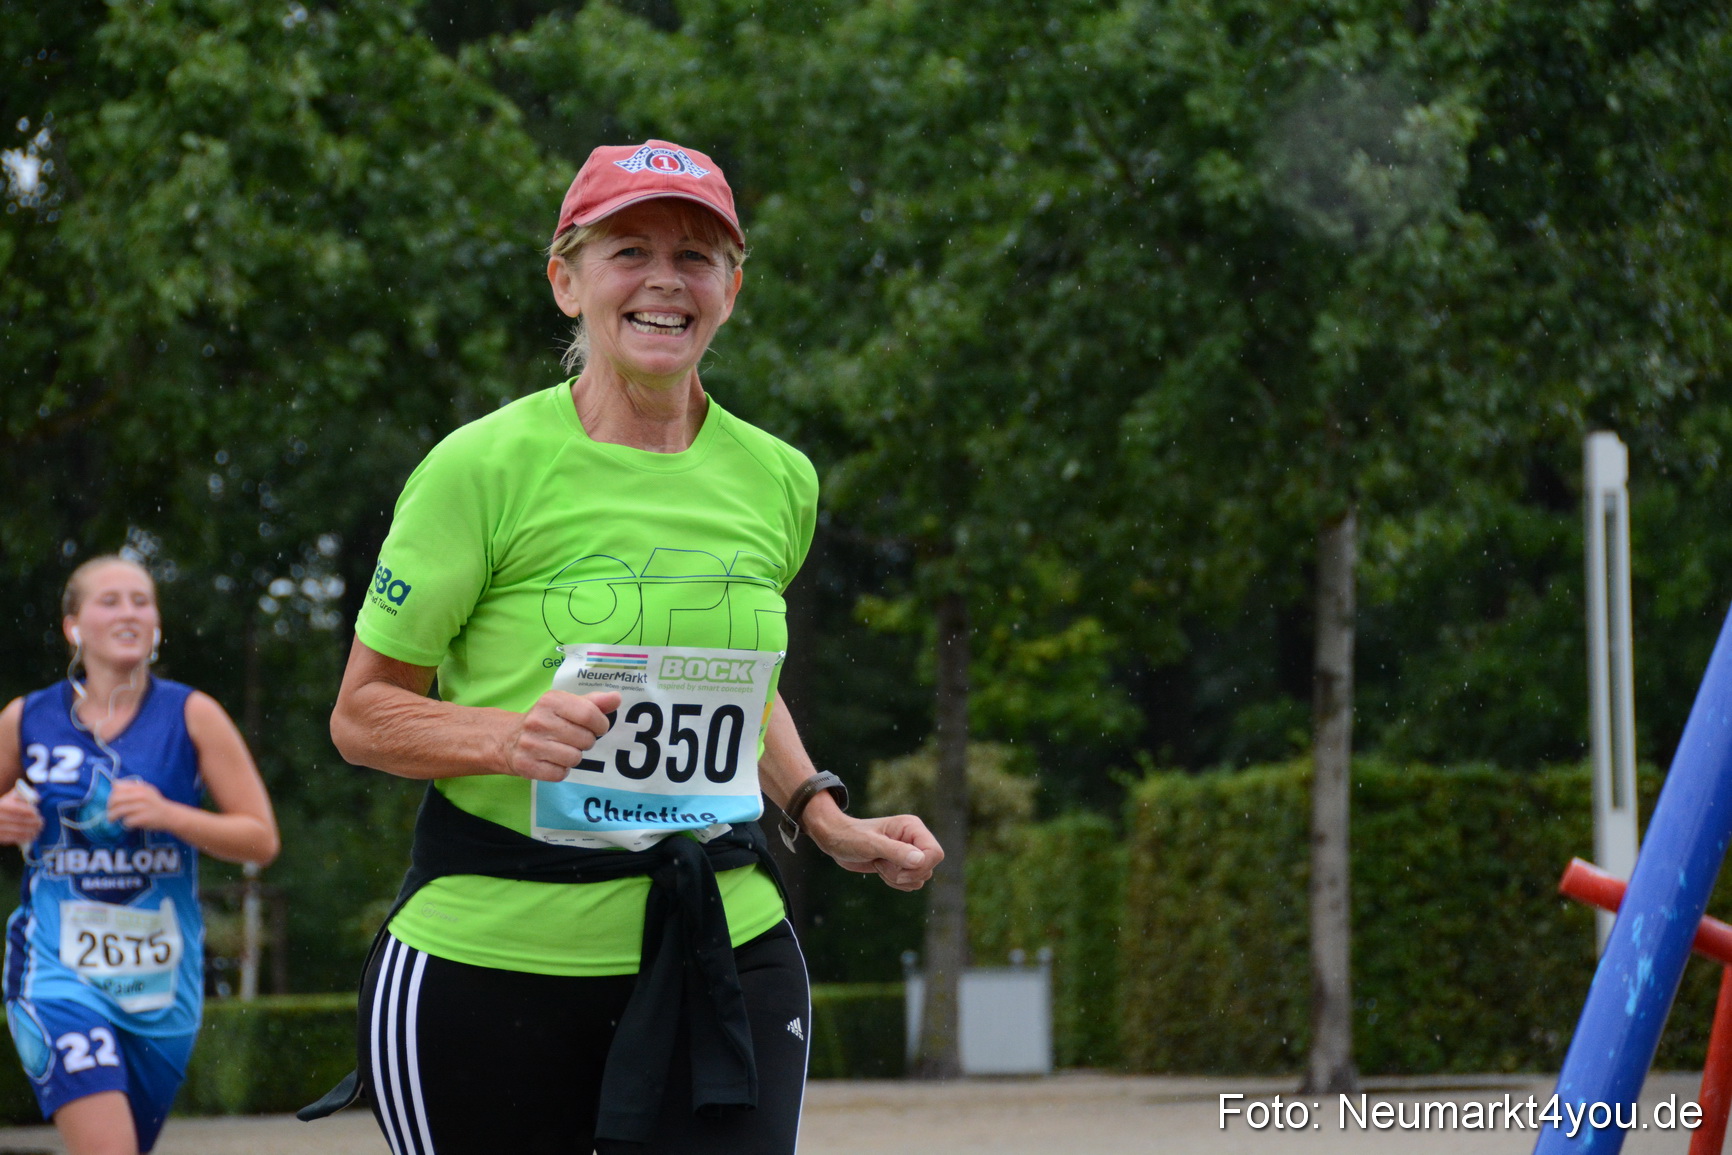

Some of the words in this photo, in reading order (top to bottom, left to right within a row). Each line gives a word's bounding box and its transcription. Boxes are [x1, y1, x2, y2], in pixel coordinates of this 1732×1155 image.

[658, 156, 673, 170] 1
[378, 598, 398, 617] Türen
[577, 668, 648, 684] NeuerMarkt
[658, 655, 757, 684] BOCK
[687, 683, 697, 692] by
[720, 686, 754, 694] concepts
[26, 744, 84, 783] 22
[78, 930, 171, 968] 2675
[56, 1028, 120, 1073] 22
